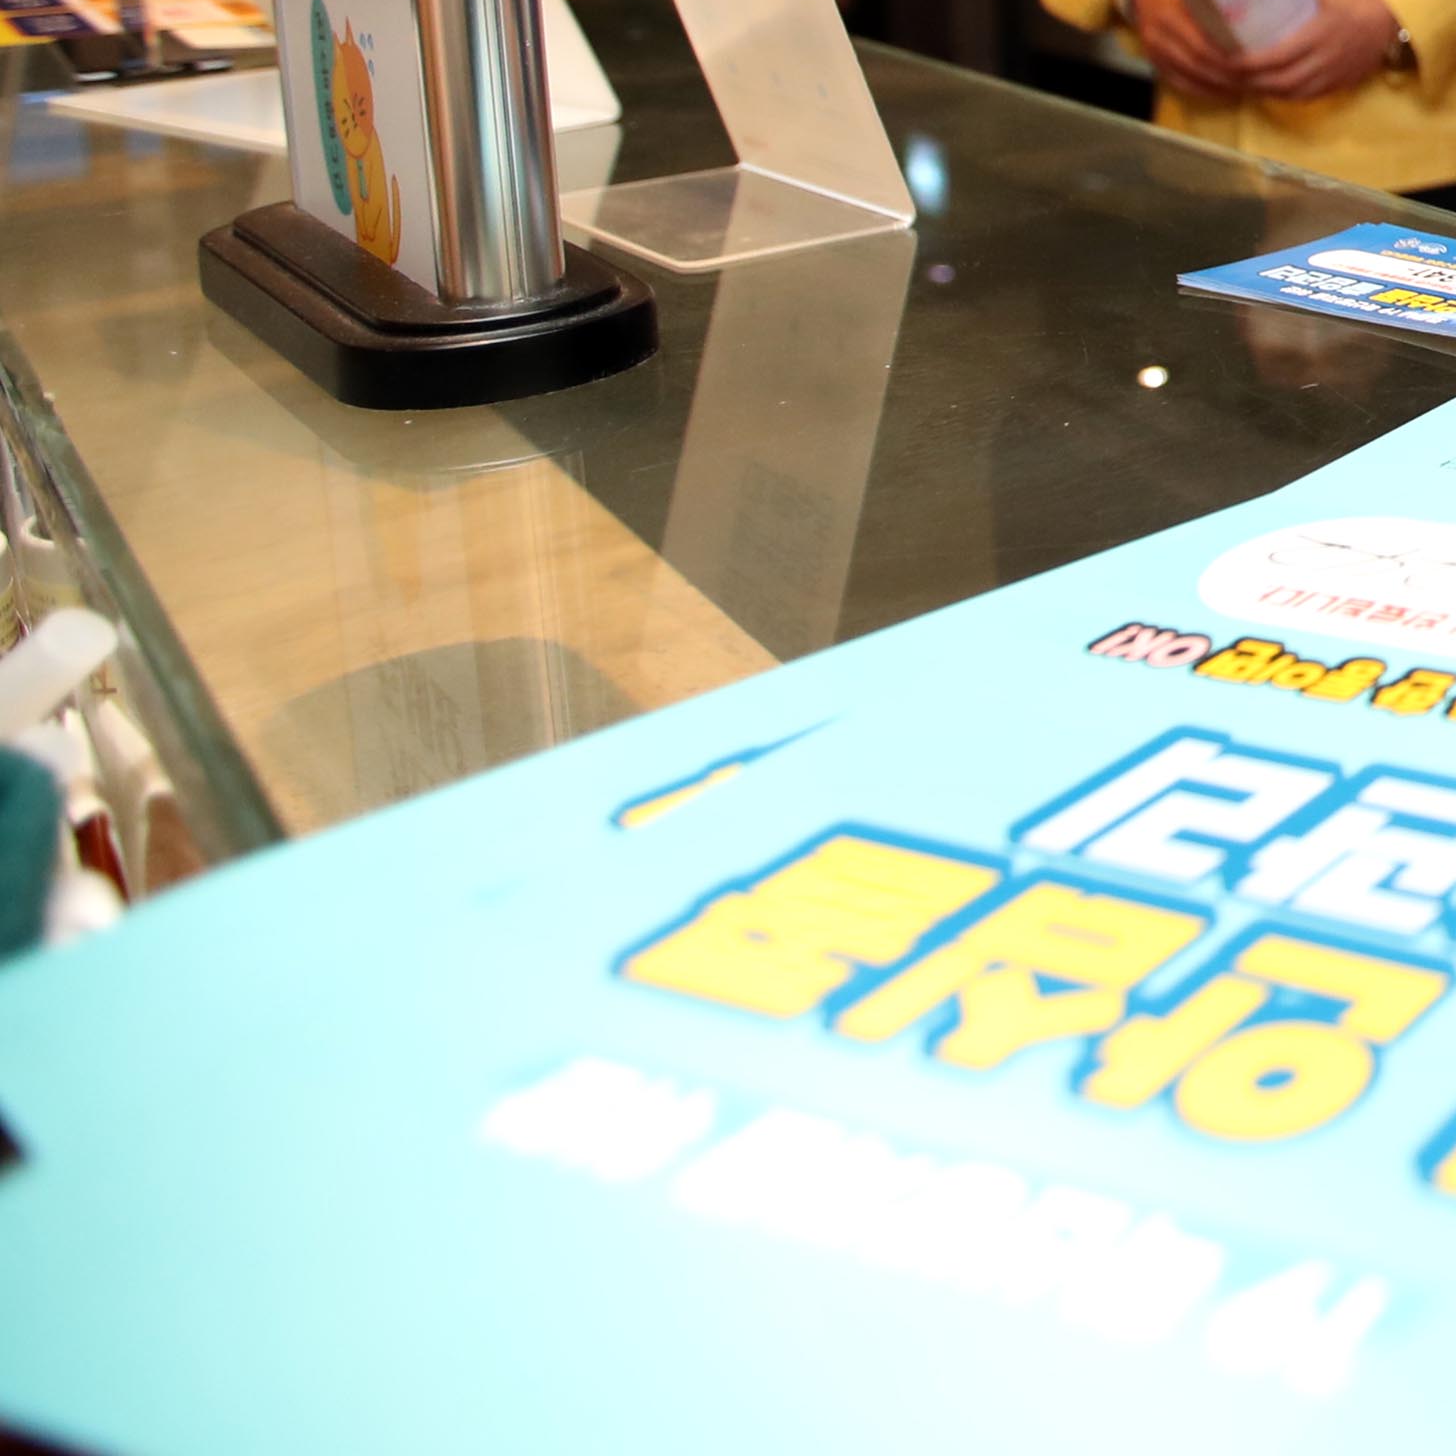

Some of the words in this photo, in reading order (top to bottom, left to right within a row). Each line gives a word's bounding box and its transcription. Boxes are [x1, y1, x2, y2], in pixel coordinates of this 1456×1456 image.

[1257, 585, 1449, 631] 완료됩니다
[1084, 621, 1208, 669] OK!
[611, 828, 1455, 1144] 안심콜
